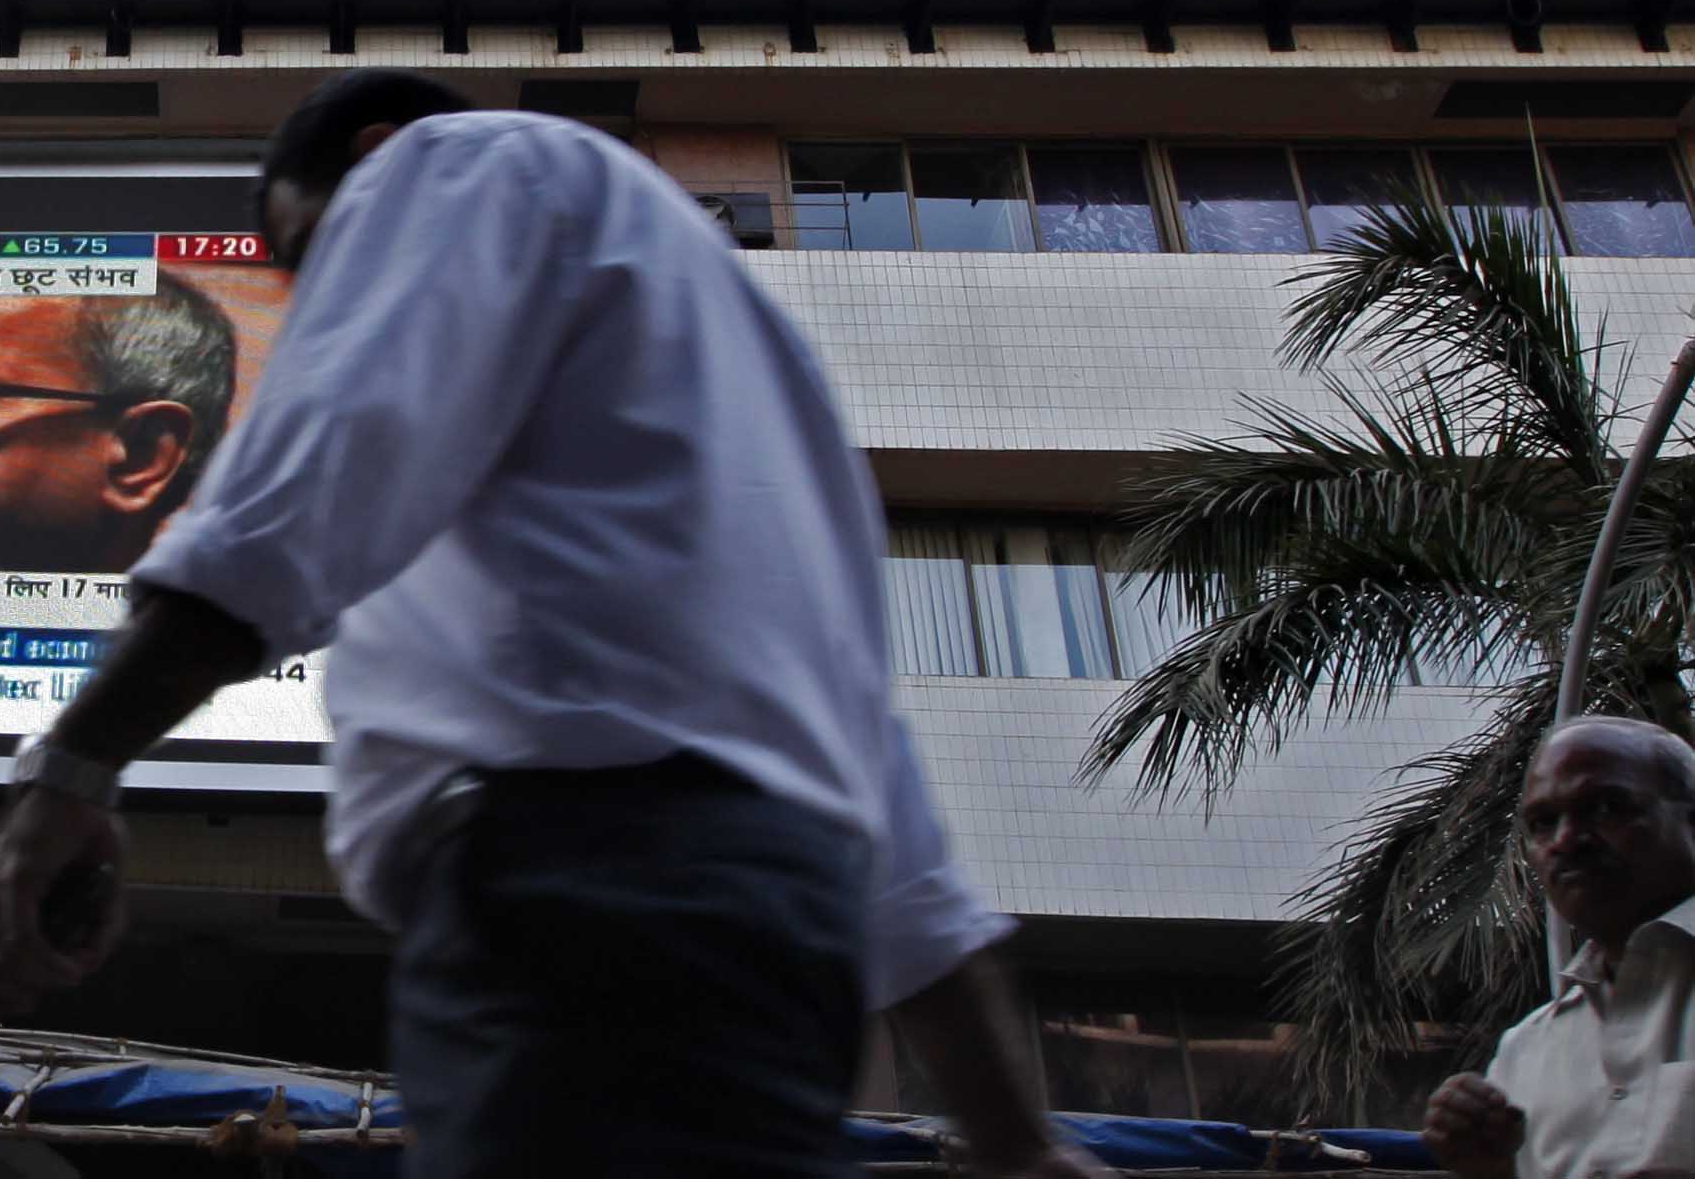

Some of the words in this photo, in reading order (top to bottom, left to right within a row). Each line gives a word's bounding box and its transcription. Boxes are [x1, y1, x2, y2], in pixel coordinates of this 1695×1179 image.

[23, 237, 108, 255] 65.75
[177, 236, 257, 256] 17:20
[10, 267, 59, 295] छूट
[66, 265, 139, 288] संभव
[5, 575, 54, 599] लिए
[61, 578, 87, 598] 17
